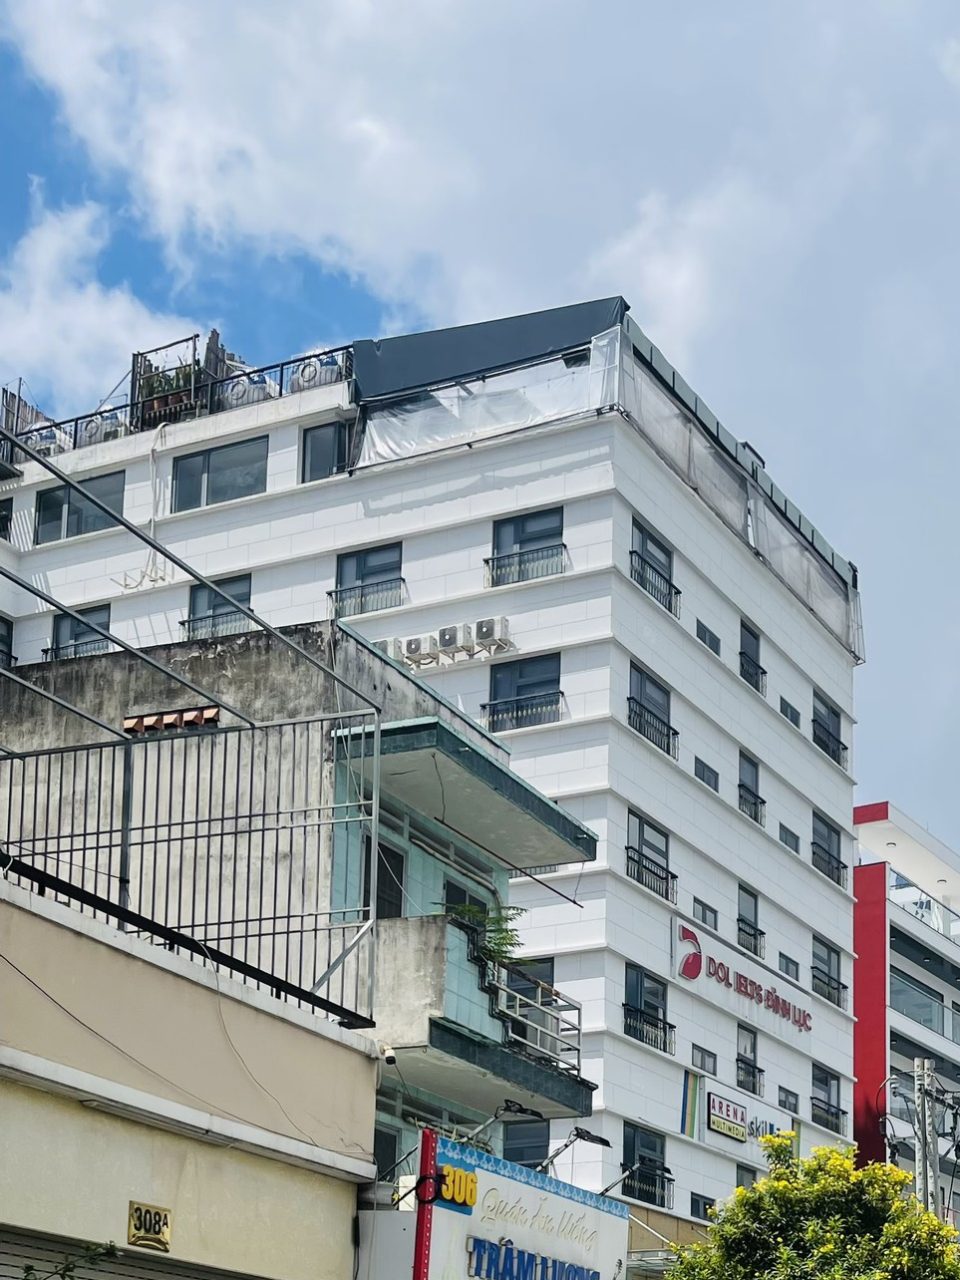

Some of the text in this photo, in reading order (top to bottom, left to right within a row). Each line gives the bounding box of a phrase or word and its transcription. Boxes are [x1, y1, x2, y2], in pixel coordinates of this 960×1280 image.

[706, 956, 733, 989] DOL
[710, 1096, 746, 1123] ARENA
[711, 1118, 746, 1138] MULTIMEDIA
[441, 1163, 479, 1207] 306
[134, 1206, 168, 1236] 308A
